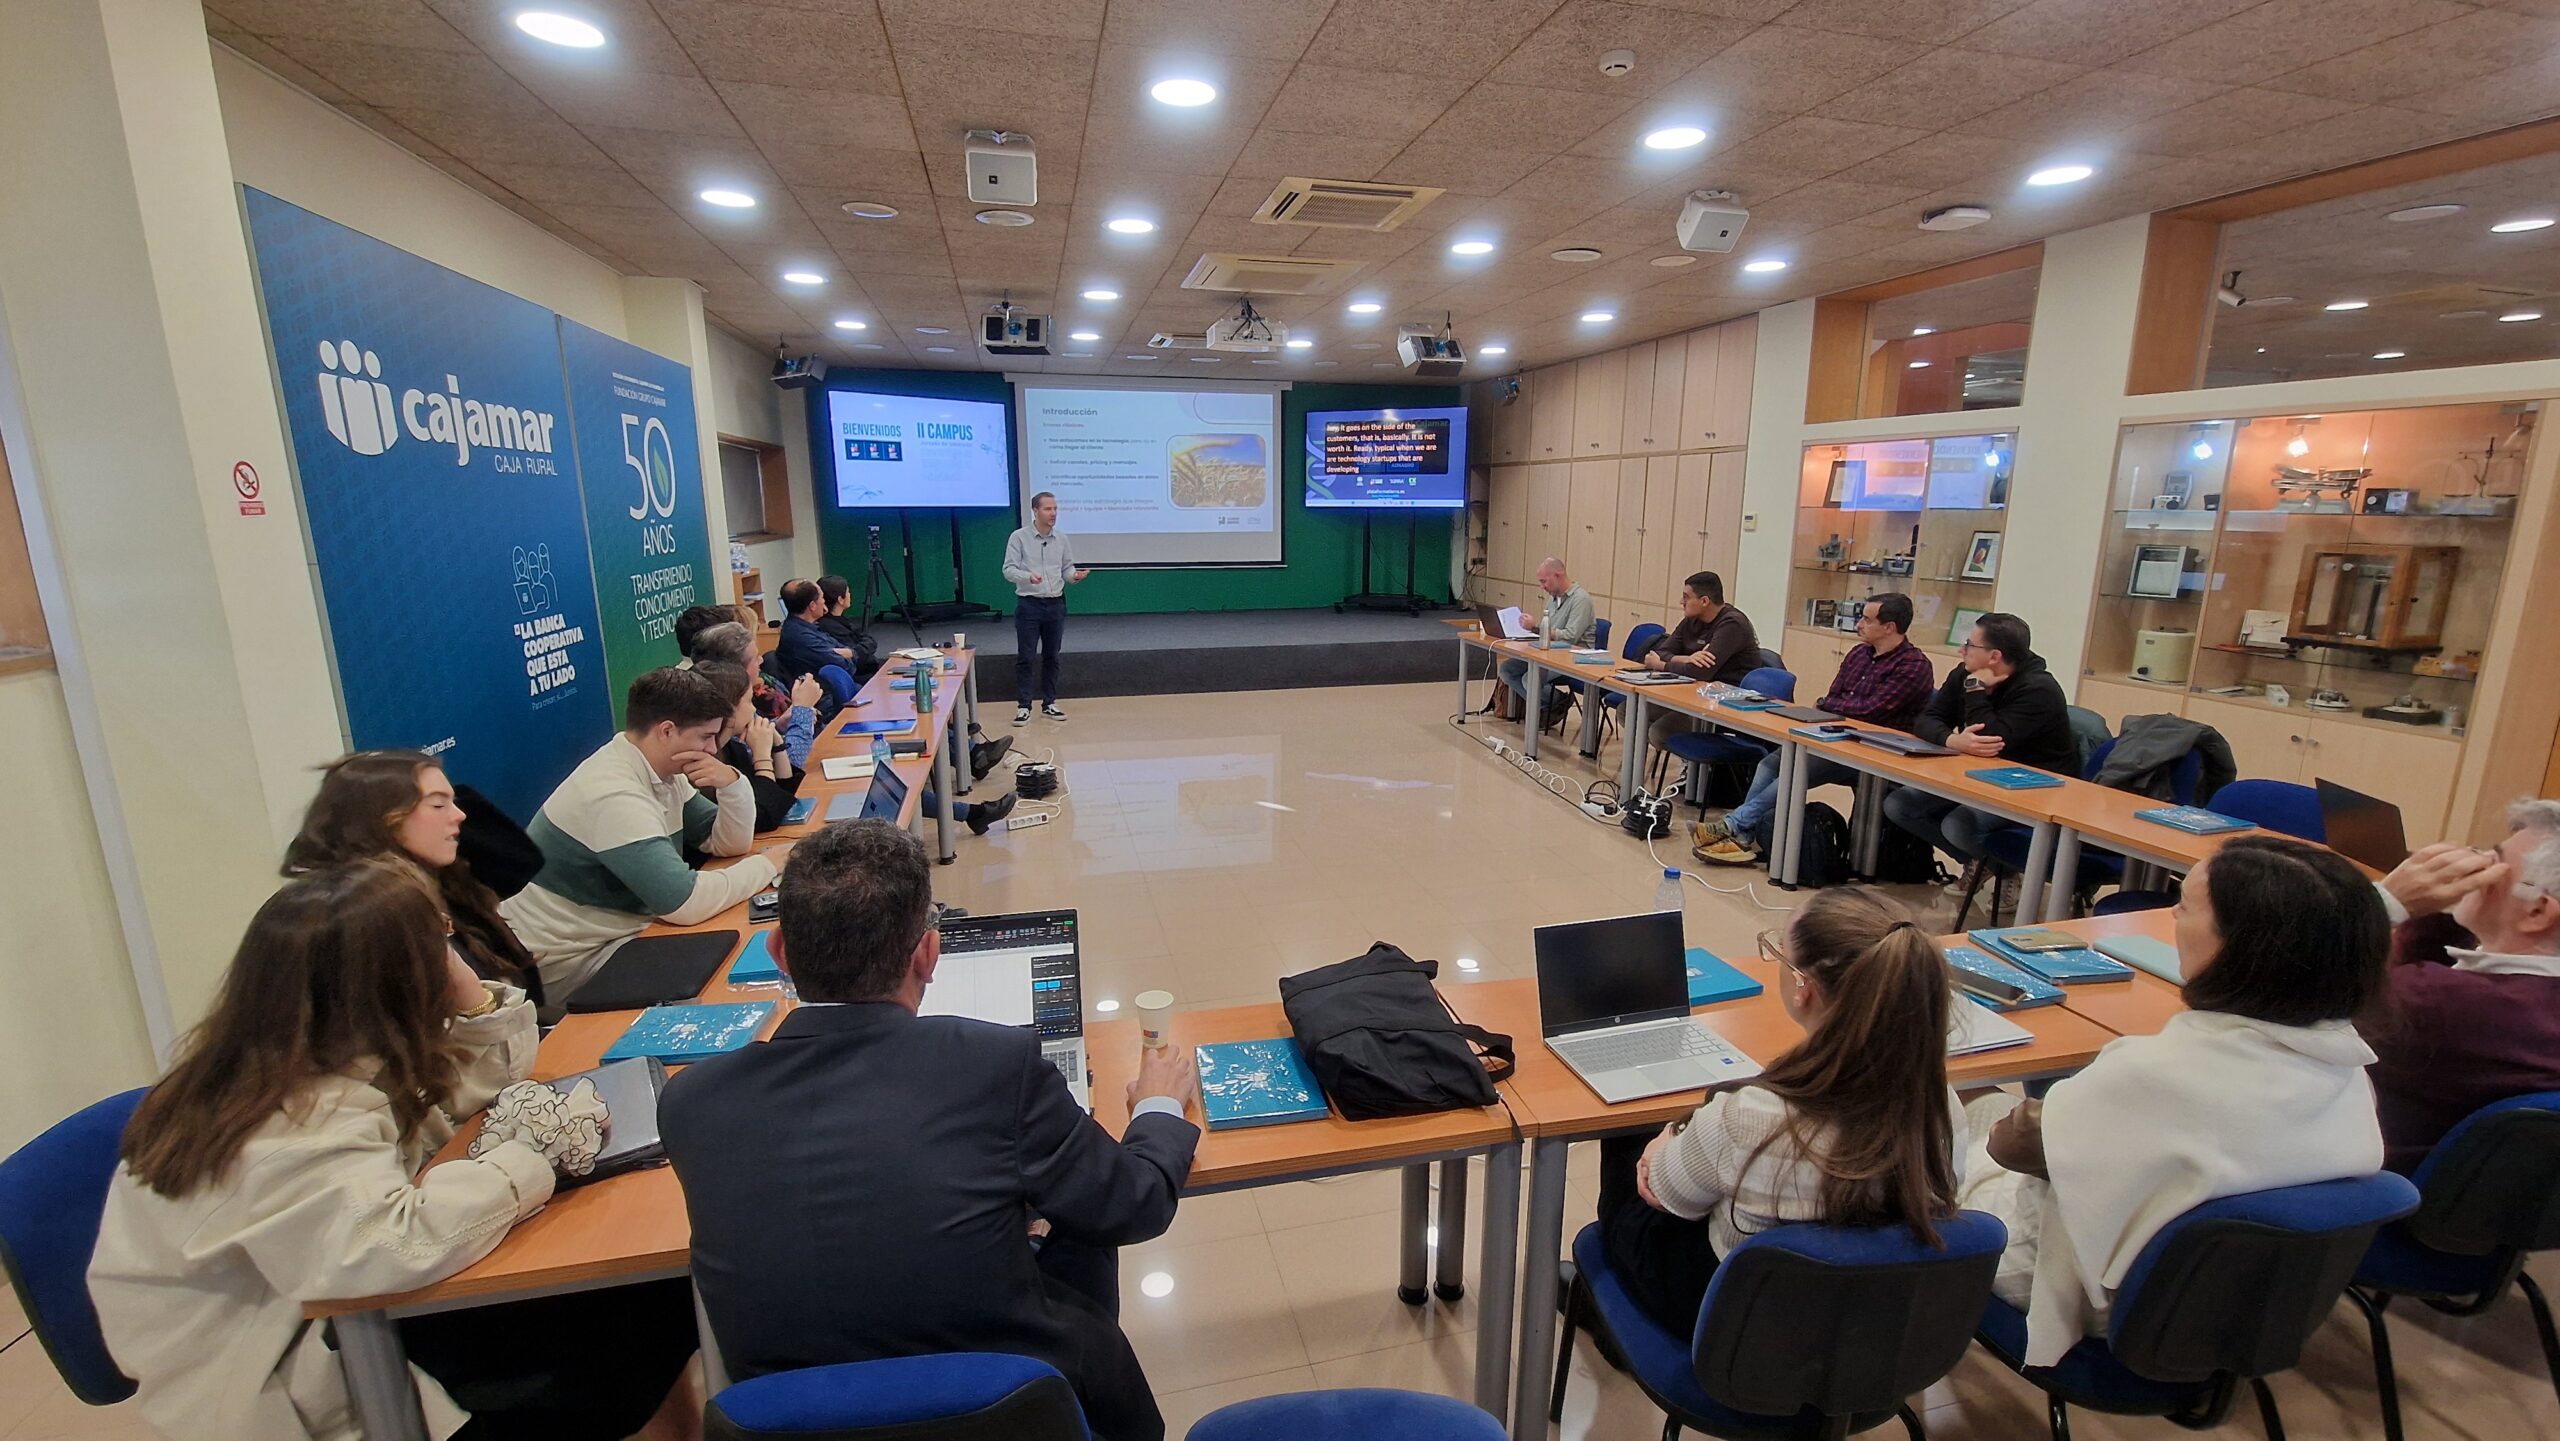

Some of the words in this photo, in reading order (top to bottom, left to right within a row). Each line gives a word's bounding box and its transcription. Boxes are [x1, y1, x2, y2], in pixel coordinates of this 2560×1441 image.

[403, 373, 553, 466] cajamar
[1042, 407, 1098, 416] Introducción
[843, 422, 901, 438] BIENVENIDOS
[917, 422, 925, 438] II
[927, 423, 973, 441] CAMPUS
[1405, 422, 1416, 430] the
[1375, 444, 1395, 452] typical
[495, 454, 523, 474] CAJA
[526, 457, 559, 476] RURAL
[621, 413, 676, 520] 50
[1327, 466, 1360, 474] developing
[1338, 455, 1371, 464] technology
[1372, 455, 1397, 463] startups
[643, 519, 676, 557] AÑOS
[630, 563, 693, 595] TRANSFIRIENDO
[635, 585, 695, 620] CONOCIMIENTO
[534, 613, 566, 636] BANCA
[640, 623, 647, 643] Y
[523, 626, 584, 658] COOPERATIVA
[526, 656, 547, 677] QUE
[530, 678, 539, 697] A
[538, 674, 551, 693] TU
[551, 664, 576, 688] LADO
